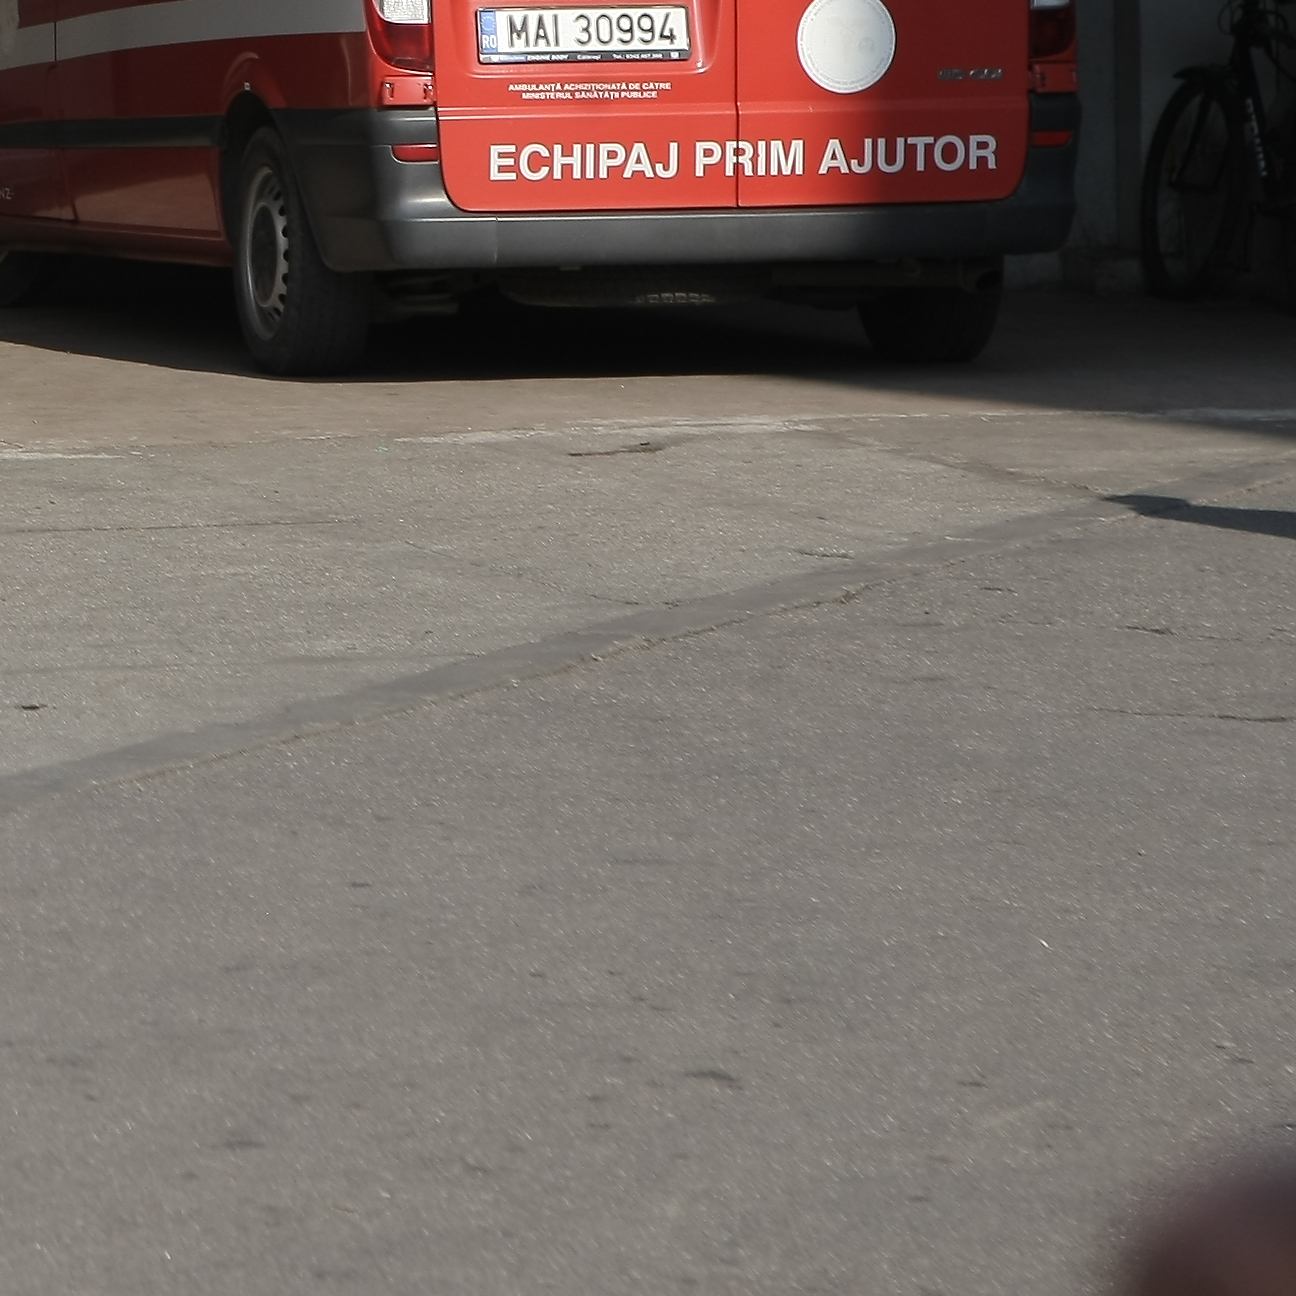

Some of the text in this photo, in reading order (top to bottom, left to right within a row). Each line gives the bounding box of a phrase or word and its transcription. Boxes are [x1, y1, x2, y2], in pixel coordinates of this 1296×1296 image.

[482, 35, 497, 49] RO
[506, 12, 676, 48] MAI 30994
[488, 134, 998, 182] ECHIPAJ PRIM AJUTOR
